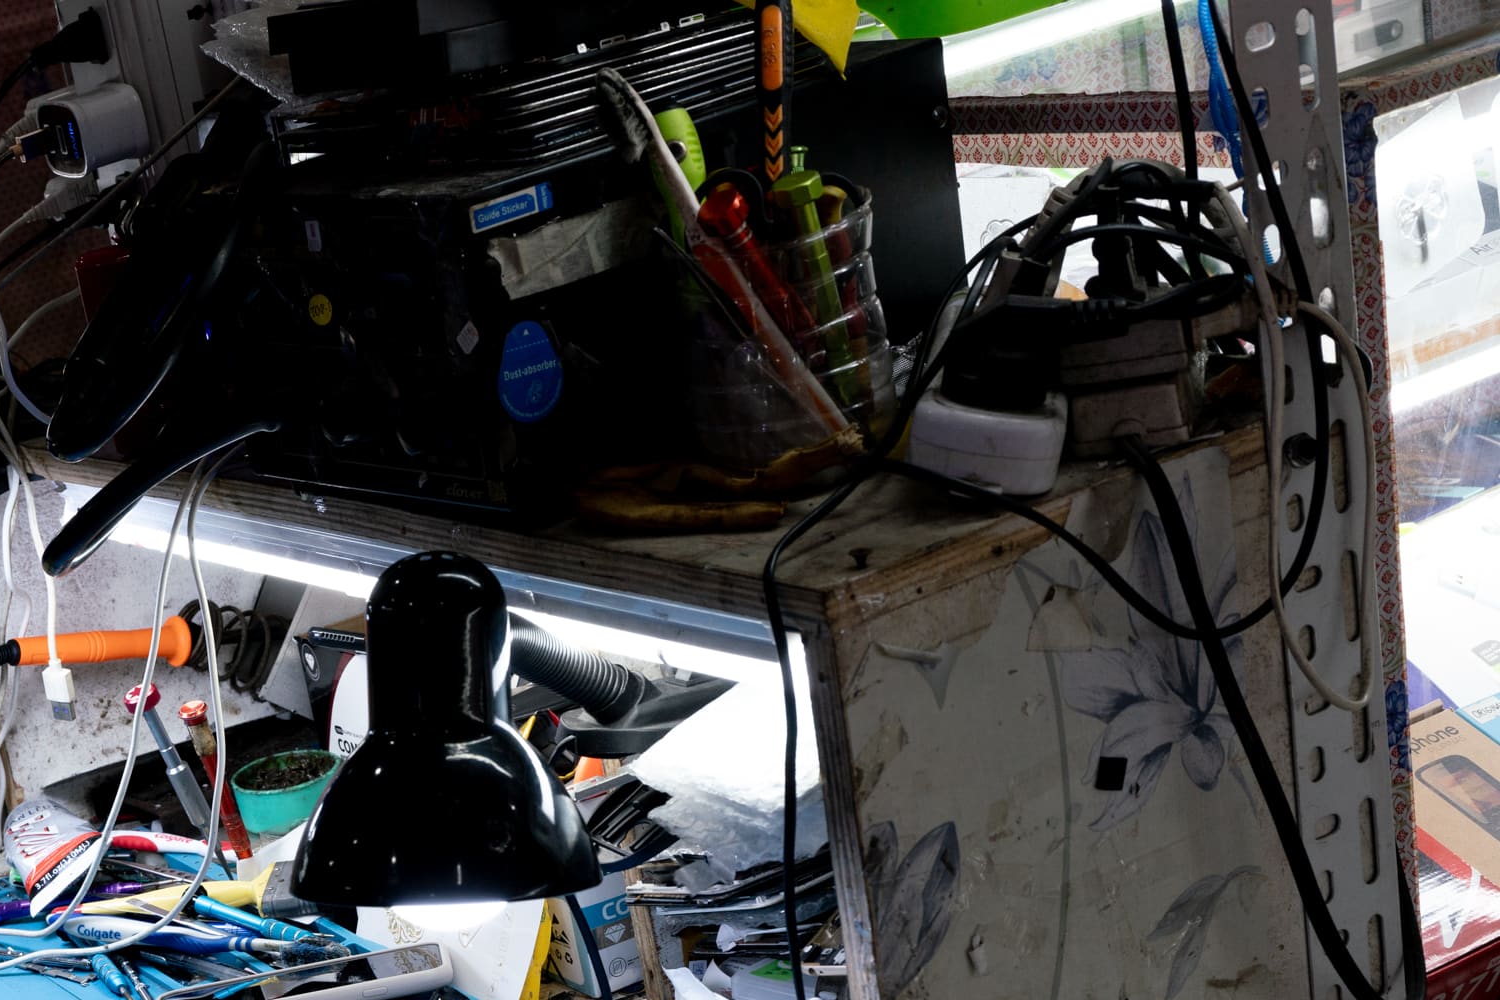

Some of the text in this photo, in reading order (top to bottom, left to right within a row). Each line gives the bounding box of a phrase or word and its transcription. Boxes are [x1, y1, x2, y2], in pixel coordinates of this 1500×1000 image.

[501, 199, 529, 216] Sticker
[503, 360, 557, 381] Dust-absorber
[77, 924, 122, 940] Colgate
